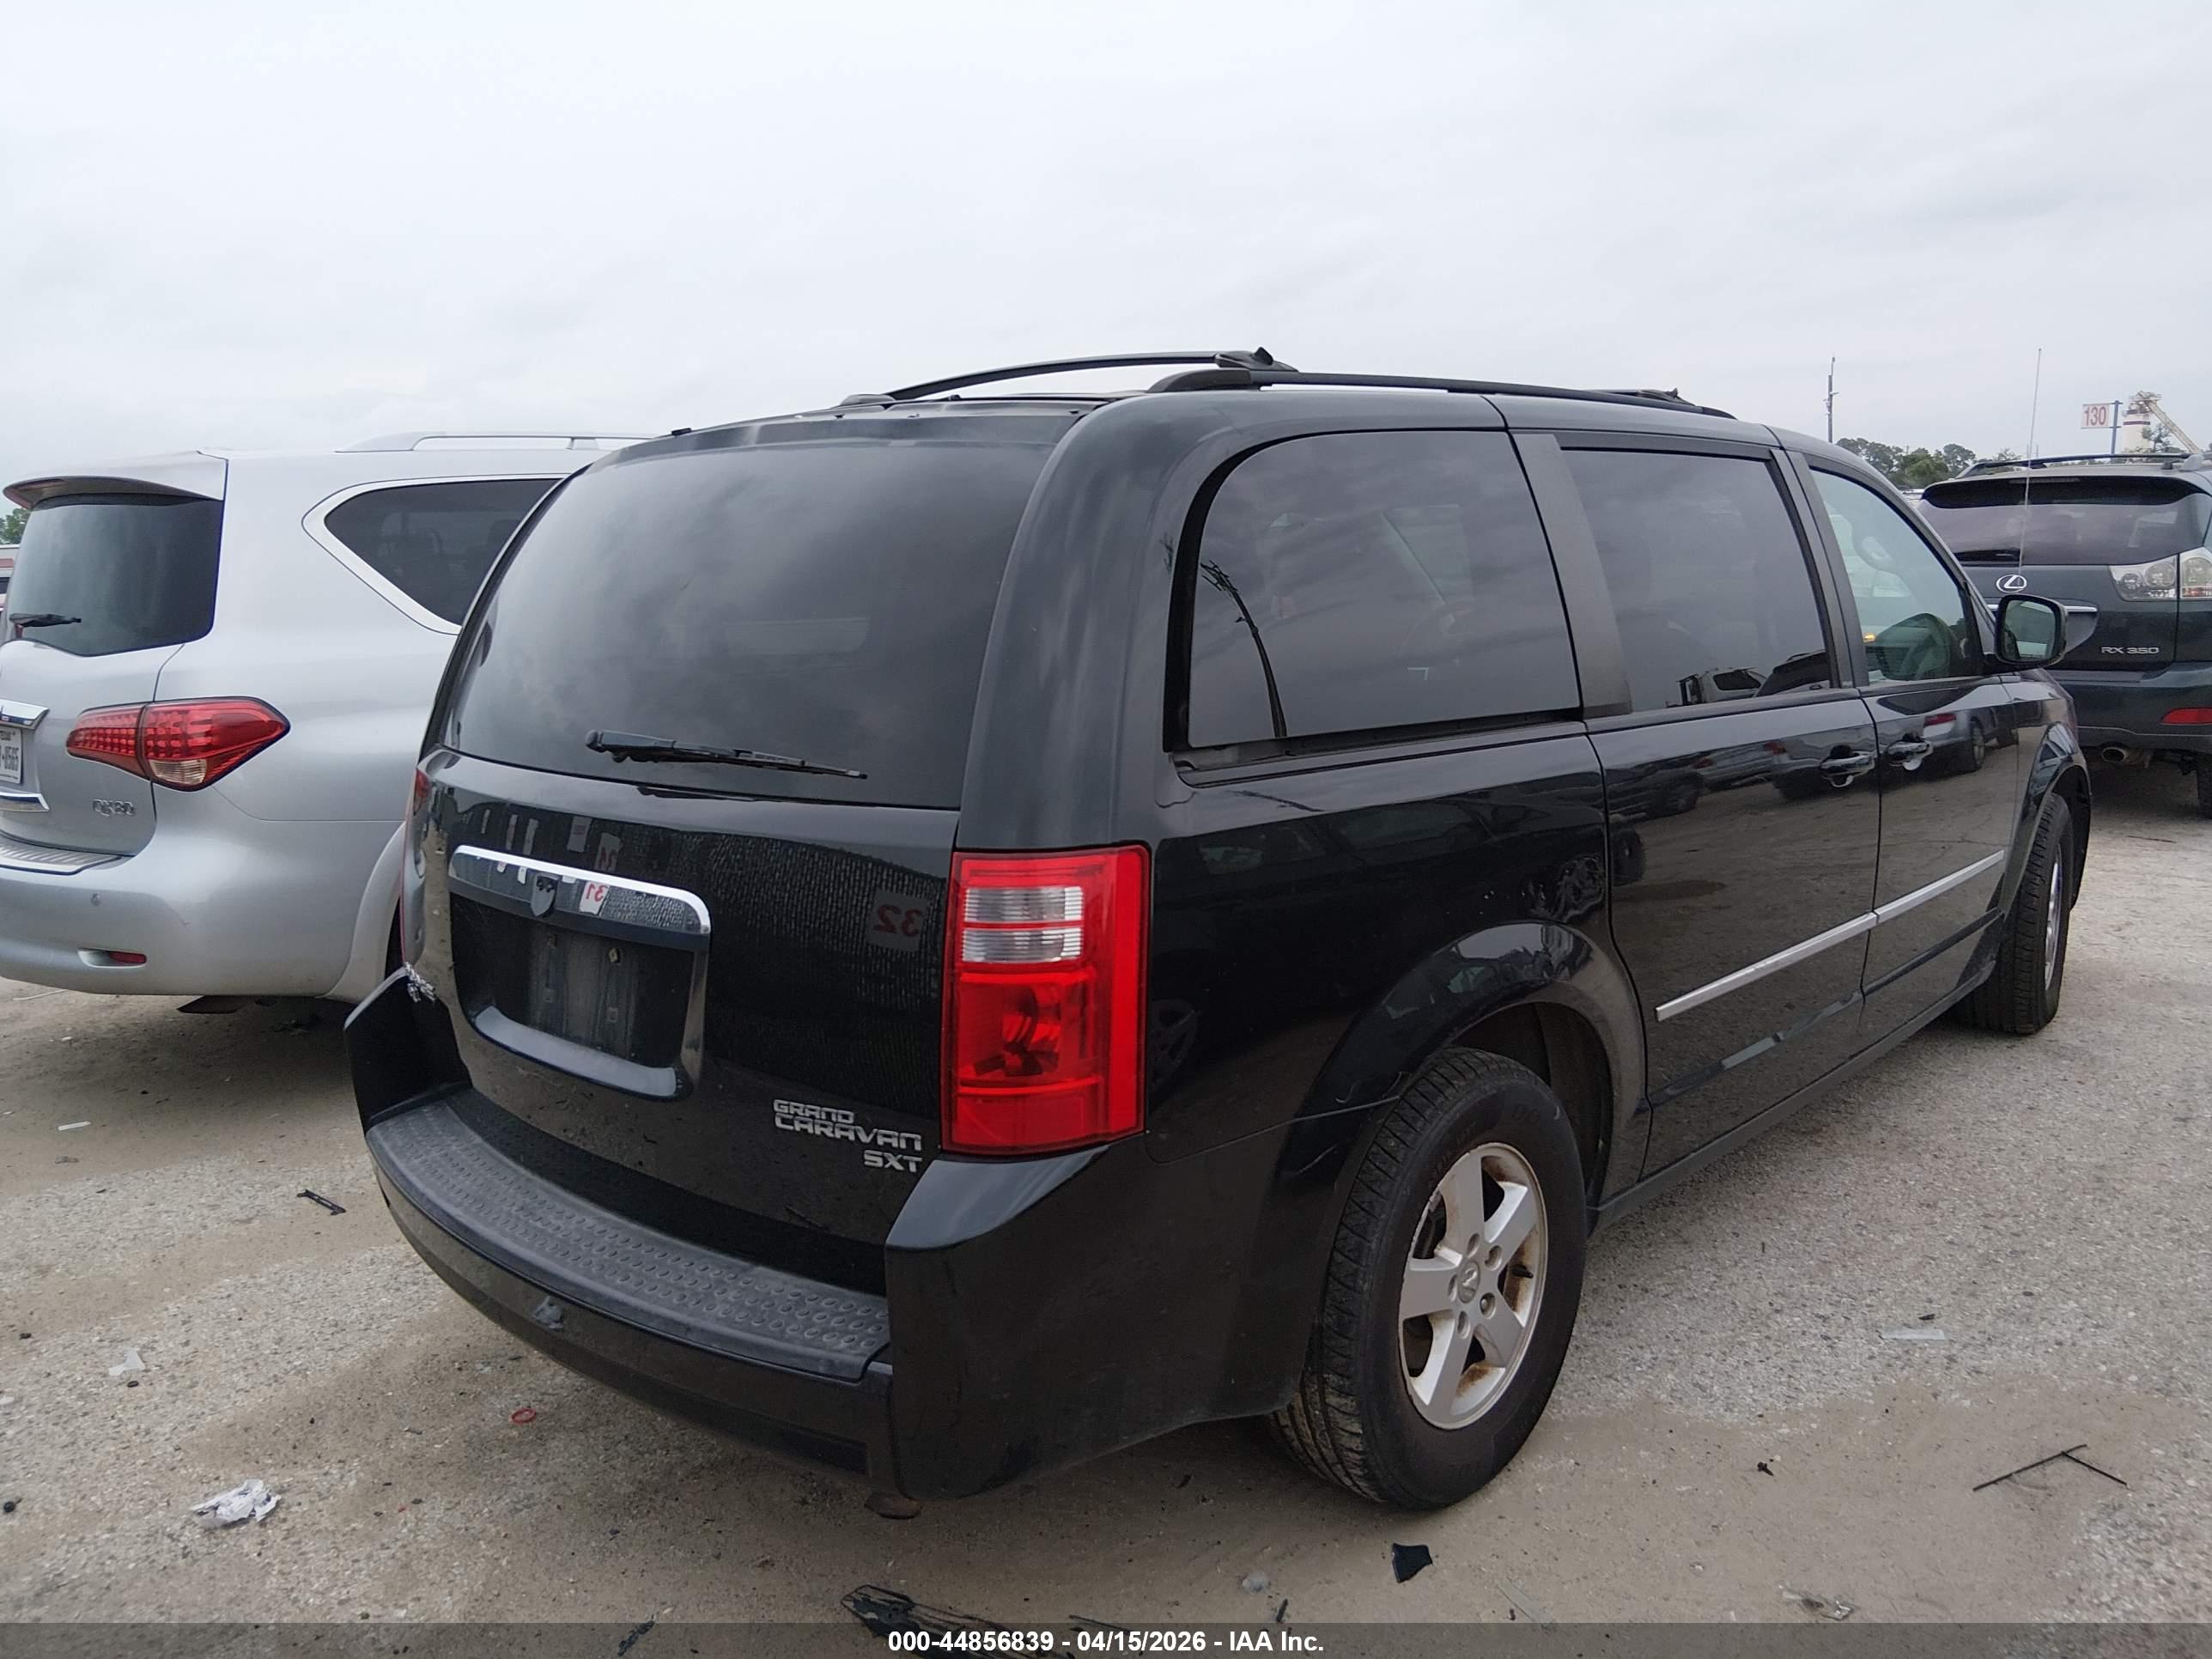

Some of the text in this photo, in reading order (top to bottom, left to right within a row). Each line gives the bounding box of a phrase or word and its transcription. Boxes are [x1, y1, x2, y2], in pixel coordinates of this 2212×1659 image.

[2084, 405, 2106, 427] 130
[773, 1099, 854, 1125] GRAND
[775, 1112, 921, 1152] CARAVAN
[864, 1149, 922, 1173] SXT
